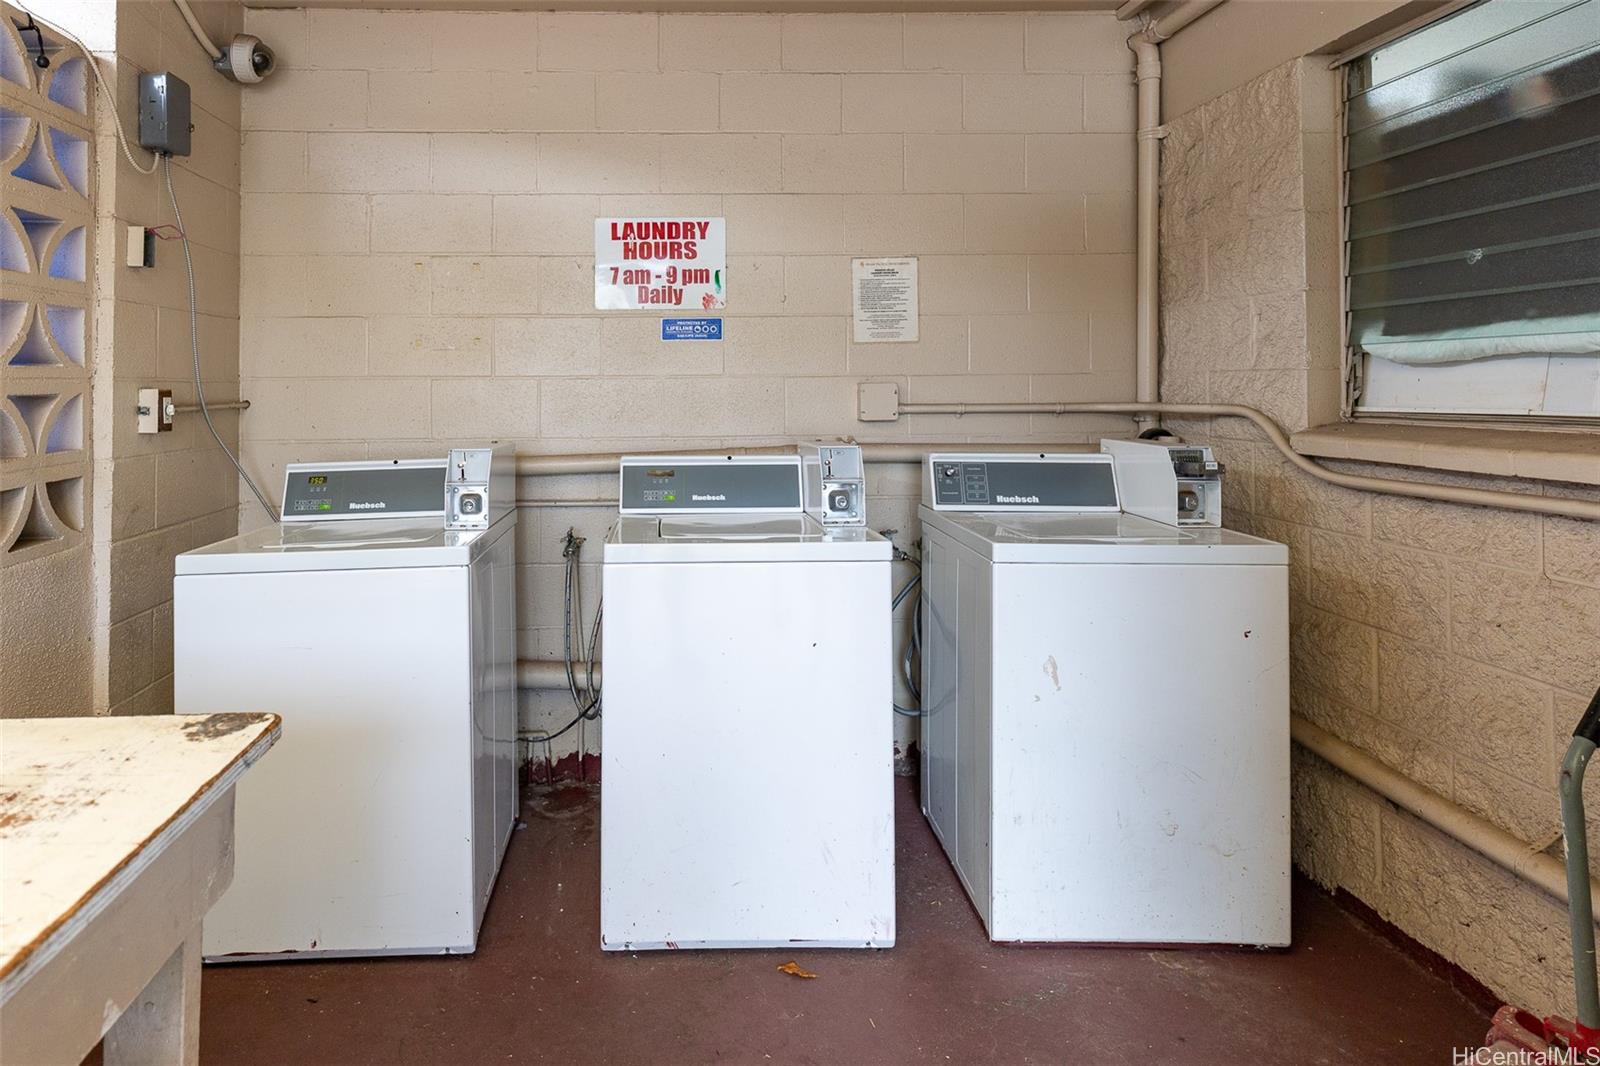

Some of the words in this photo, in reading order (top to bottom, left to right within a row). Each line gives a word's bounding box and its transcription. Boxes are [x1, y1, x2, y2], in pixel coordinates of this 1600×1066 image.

[610, 221, 710, 241] LAUNDRY
[623, 241, 698, 260] HOURS
[610, 266, 620, 285] 7
[623, 268, 651, 285] am
[666, 265, 678, 284] 9
[681, 267, 710, 286] pm
[637, 285, 684, 306] Daily
[349, 501, 386, 510] Huebsch
[996, 495, 1040, 503] Huebsch
